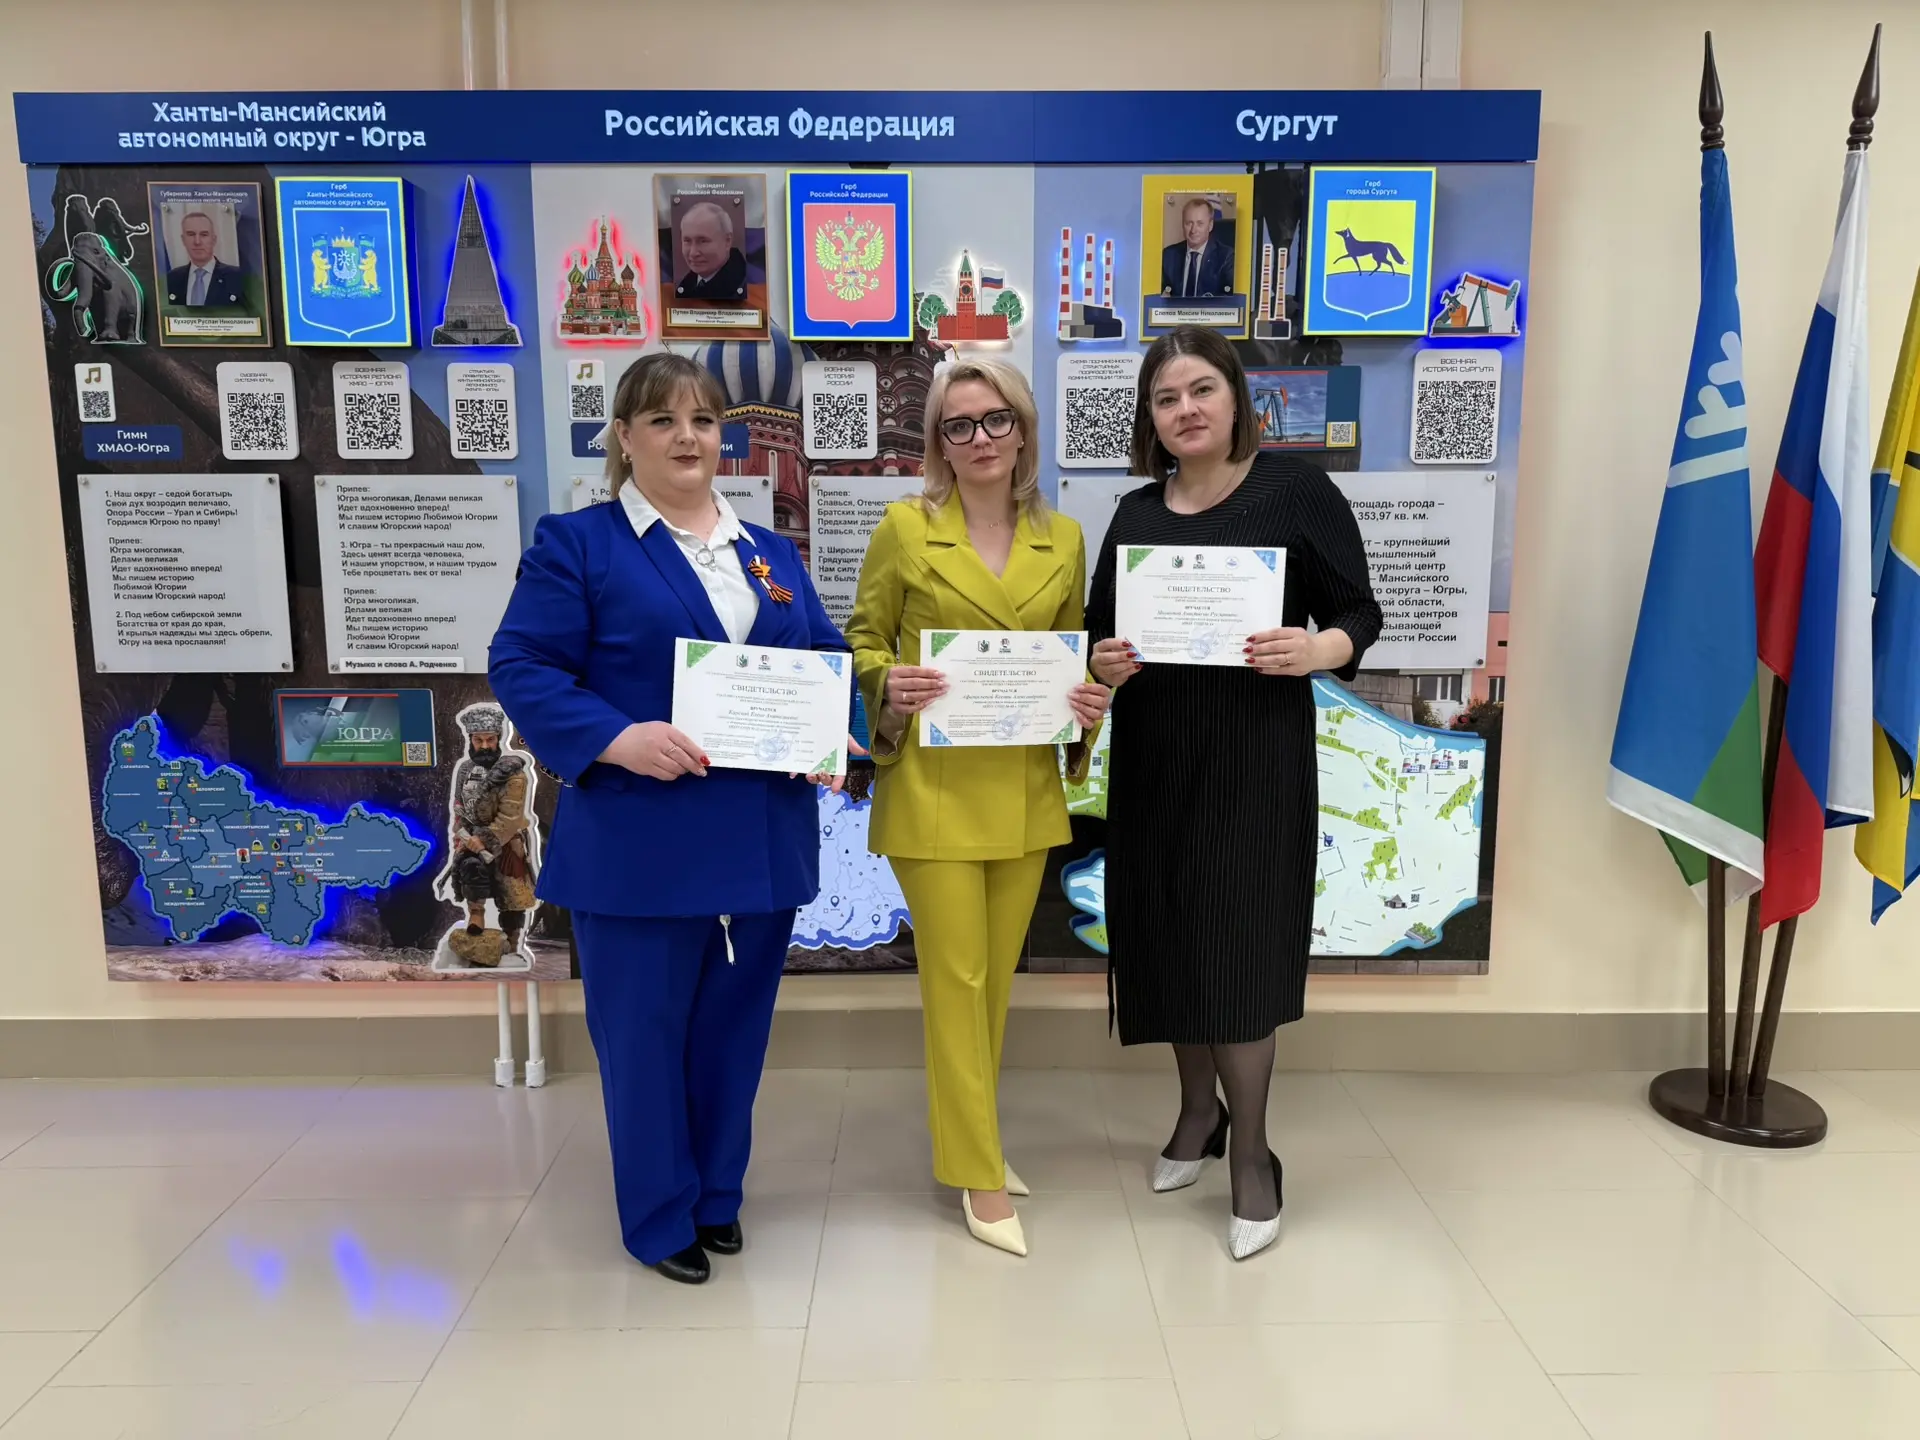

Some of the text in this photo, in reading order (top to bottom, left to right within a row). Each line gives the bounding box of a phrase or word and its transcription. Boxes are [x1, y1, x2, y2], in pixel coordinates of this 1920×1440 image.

[152, 102, 386, 124] Ханты-Мансийский
[605, 108, 954, 141] Российская Федерация
[1236, 109, 1338, 142] Сургут
[118, 127, 267, 149] автономный
[273, 131, 340, 152] округ
[361, 128, 426, 150] Югра
[840, 183, 857, 191] Герб
[1364, 180, 1381, 188] Герб
[851, 191, 888, 199] Федерации
[1370, 188, 1398, 196] Сургута
[116, 430, 148, 439] Гимн
[97, 443, 170, 454] ХМАО-Югра
[336, 485, 370, 494] Припев:
[720, 490, 754, 498] ержава,
[816, 489, 850, 498] Припев:
[165, 490, 190, 498] седой
[192, 490, 232, 499] богатырь
[337, 494, 359, 503] Югра
[413, 494, 446, 502] Делами
[337, 504, 357, 512] Идет
[416, 504, 449, 512] вперед!
[1397, 501, 1434, 509] города
[106, 509, 132, 518] Опора
[173, 509, 194, 518] Урал
[203, 509, 237, 518] Сибирь!
[817, 509, 855, 517] Братских
[1358, 512, 1391, 521] 353,97
[107, 518, 147, 527] Гордимся
[149, 518, 179, 527] Югрою
[193, 518, 220, 527] праву!
[817, 518, 858, 527] Предками
[108, 537, 142, 545] Припев:
[1383, 537, 1450, 547] крупнейший
[827, 546, 865, 555] Широкий
[1366, 549, 1436, 557] мышленный
[818, 556, 858, 564] Грядущие
[1414, 563, 1445, 572] центр
[1385, 587, 1420, 595] округа
[1433, 585, 1467, 595] Югры,
[819, 593, 851, 602] Припев:
[1398, 597, 1444, 607] области,
[124, 611, 141, 619] Под
[170, 611, 214, 619] сибирской
[1413, 611, 1457, 619] центров
[1382, 621, 1441, 630] бывающей
[239, 629, 272, 638] обрели,
[118, 638, 140, 647] Югру
[174, 638, 225, 647] прославляя!
[345, 660, 376, 669] Музыка
[731, 684, 797, 696] СВИДЕТЕЛЬСТВО
[337, 727, 394, 740] ЮГРА
